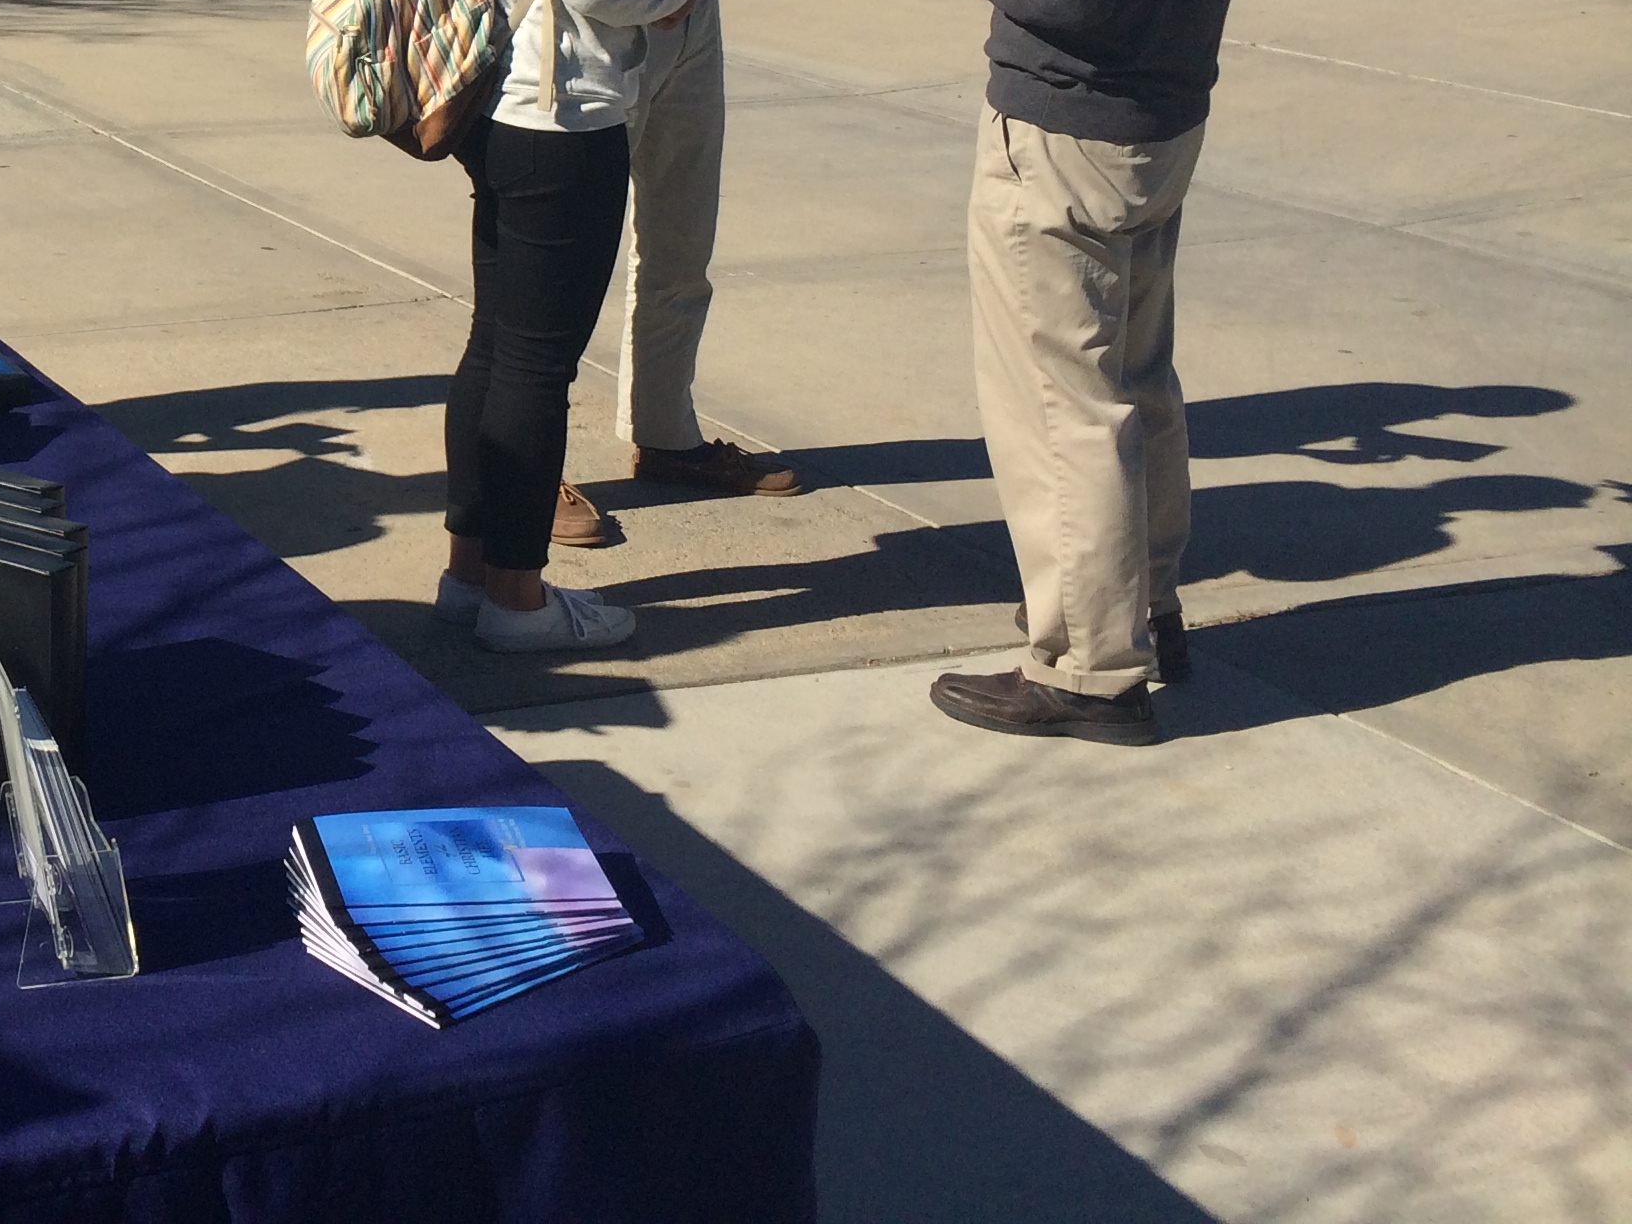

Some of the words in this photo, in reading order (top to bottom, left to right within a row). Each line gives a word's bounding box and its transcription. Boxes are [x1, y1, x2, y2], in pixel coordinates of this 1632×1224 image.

[390, 839, 413, 866] BASIC
[407, 827, 438, 876] ELEMENTS
[449, 826, 481, 876] CHRISTIAN
